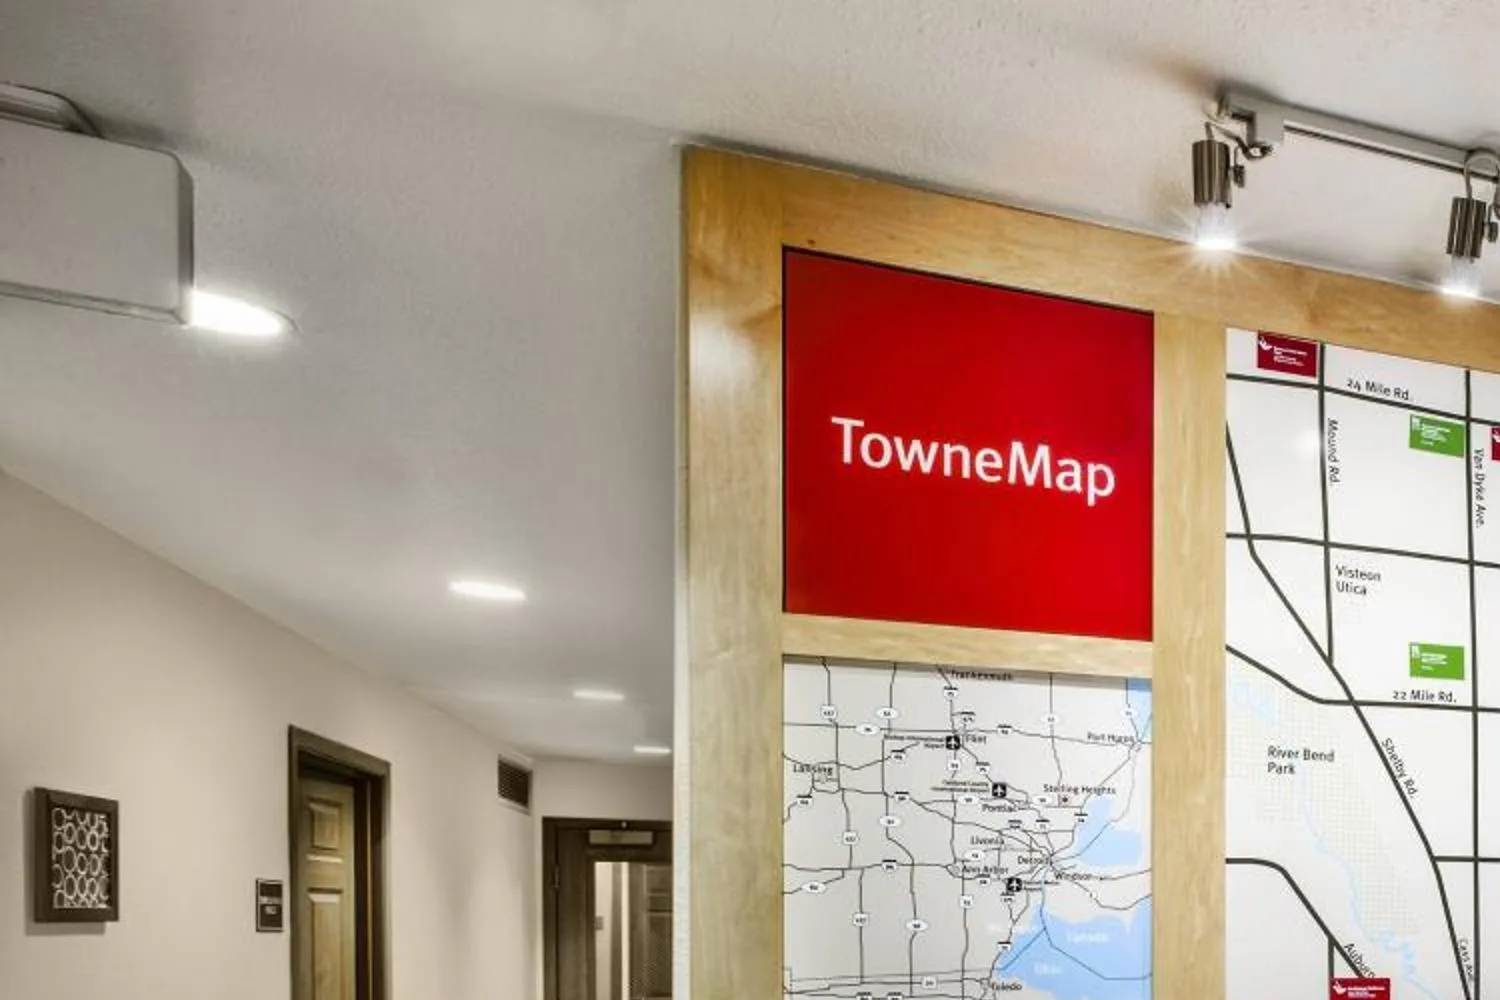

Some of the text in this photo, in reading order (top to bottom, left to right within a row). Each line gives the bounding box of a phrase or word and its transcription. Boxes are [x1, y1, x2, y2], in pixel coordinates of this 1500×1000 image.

[1365, 381, 1391, 397] Mile
[1327, 418, 1339, 463] Mound
[831, 416, 1116, 507] TowneMap
[1335, 563, 1382, 582] Visteon
[1335, 580, 1368, 597] Utica
[1410, 688, 1436, 703] Mile
[1267, 745, 1335, 764] River Bend
[1381, 737, 1407, 780] Shelby
[1267, 760, 1296, 776] Park
[1082, 786, 1117, 798] Heights
